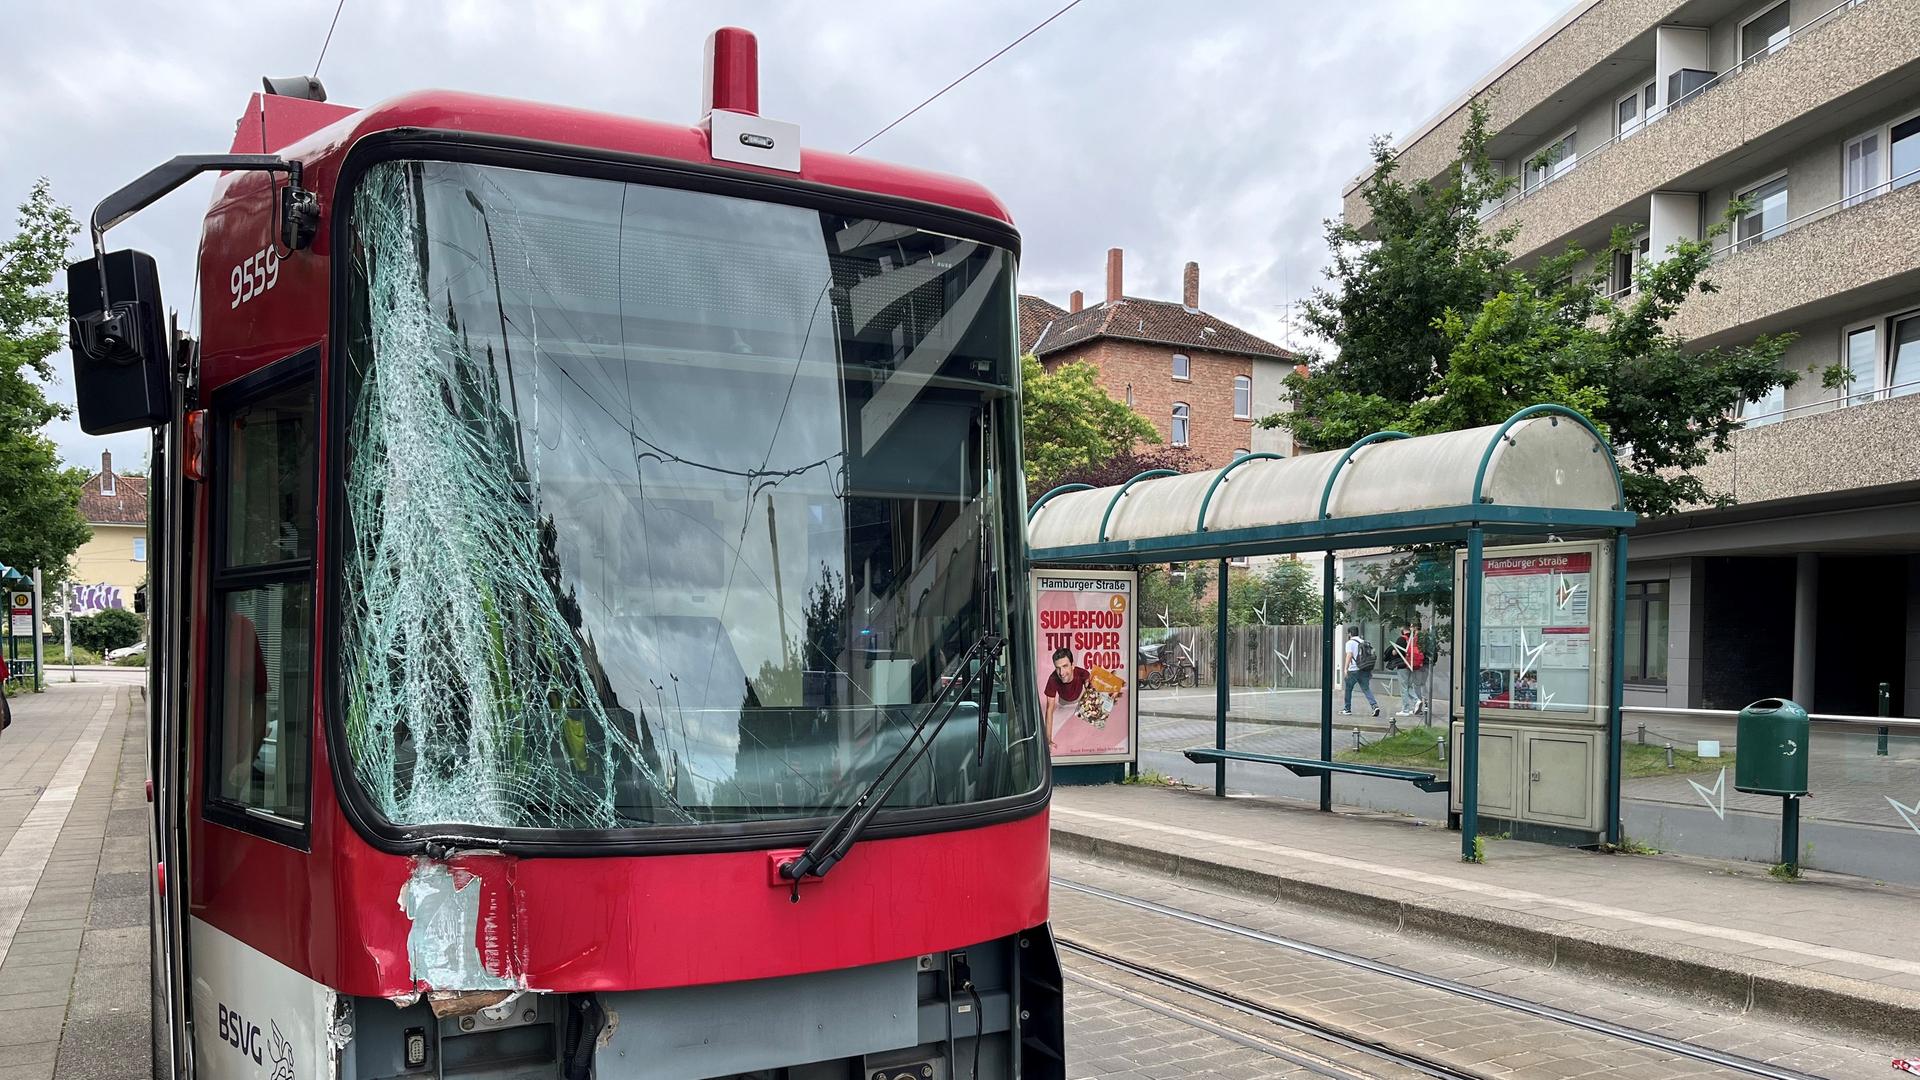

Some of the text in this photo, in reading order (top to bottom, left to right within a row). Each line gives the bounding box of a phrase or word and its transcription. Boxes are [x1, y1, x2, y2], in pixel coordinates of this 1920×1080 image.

[230, 243, 279, 310] 9559
[1487, 556, 1568, 569] Hamburger Straße
[1041, 578, 1126, 591] Hamburger Straße
[1040, 610, 1124, 629] SUPERFOOD
[1045, 631, 1120, 651] TUT SUPER
[1083, 651, 1125, 669] GOOD.
[218, 1002, 263, 1067] BSVG
